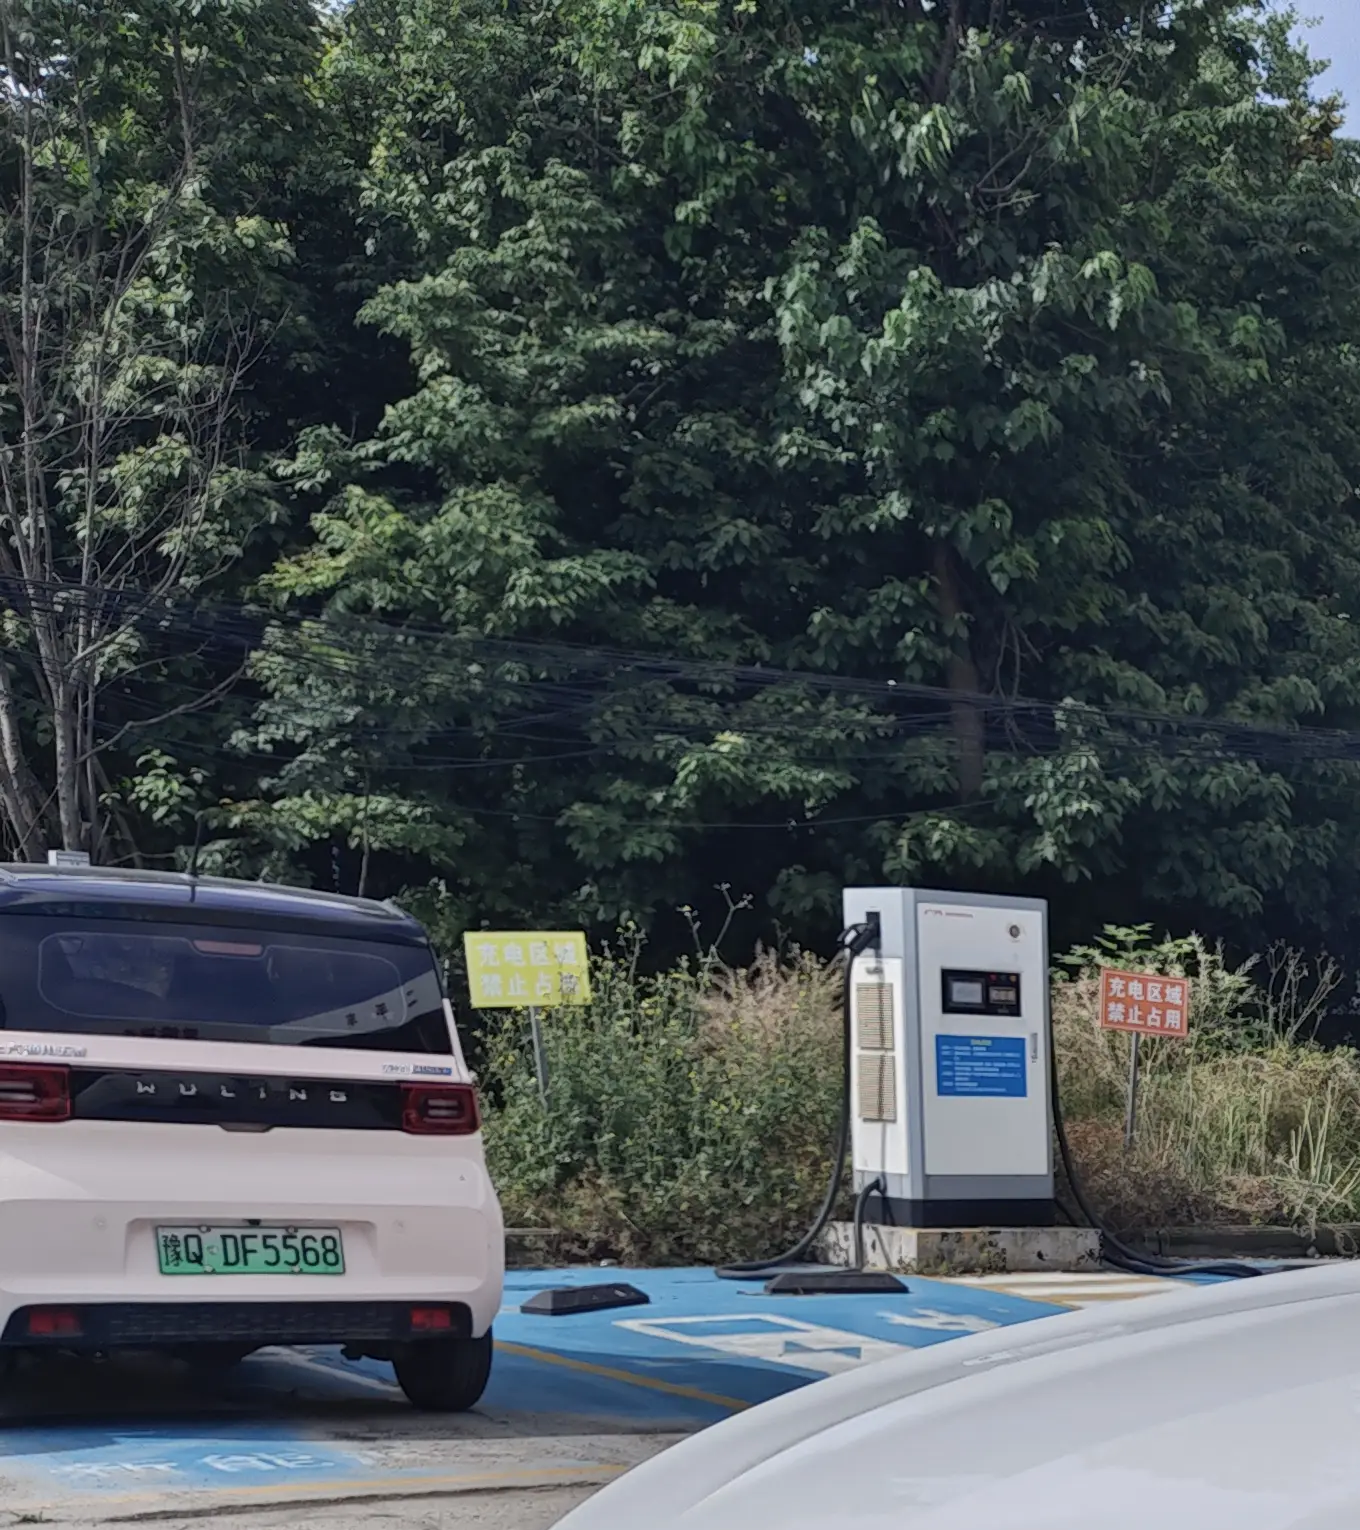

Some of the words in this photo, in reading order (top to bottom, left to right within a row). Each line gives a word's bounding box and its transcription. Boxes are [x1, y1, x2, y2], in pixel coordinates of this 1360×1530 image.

[1108, 977, 1182, 1006] 充电区域
[1107, 1001, 1181, 1030] 禁止占用
[220, 1234, 340, 1267] DF5568
